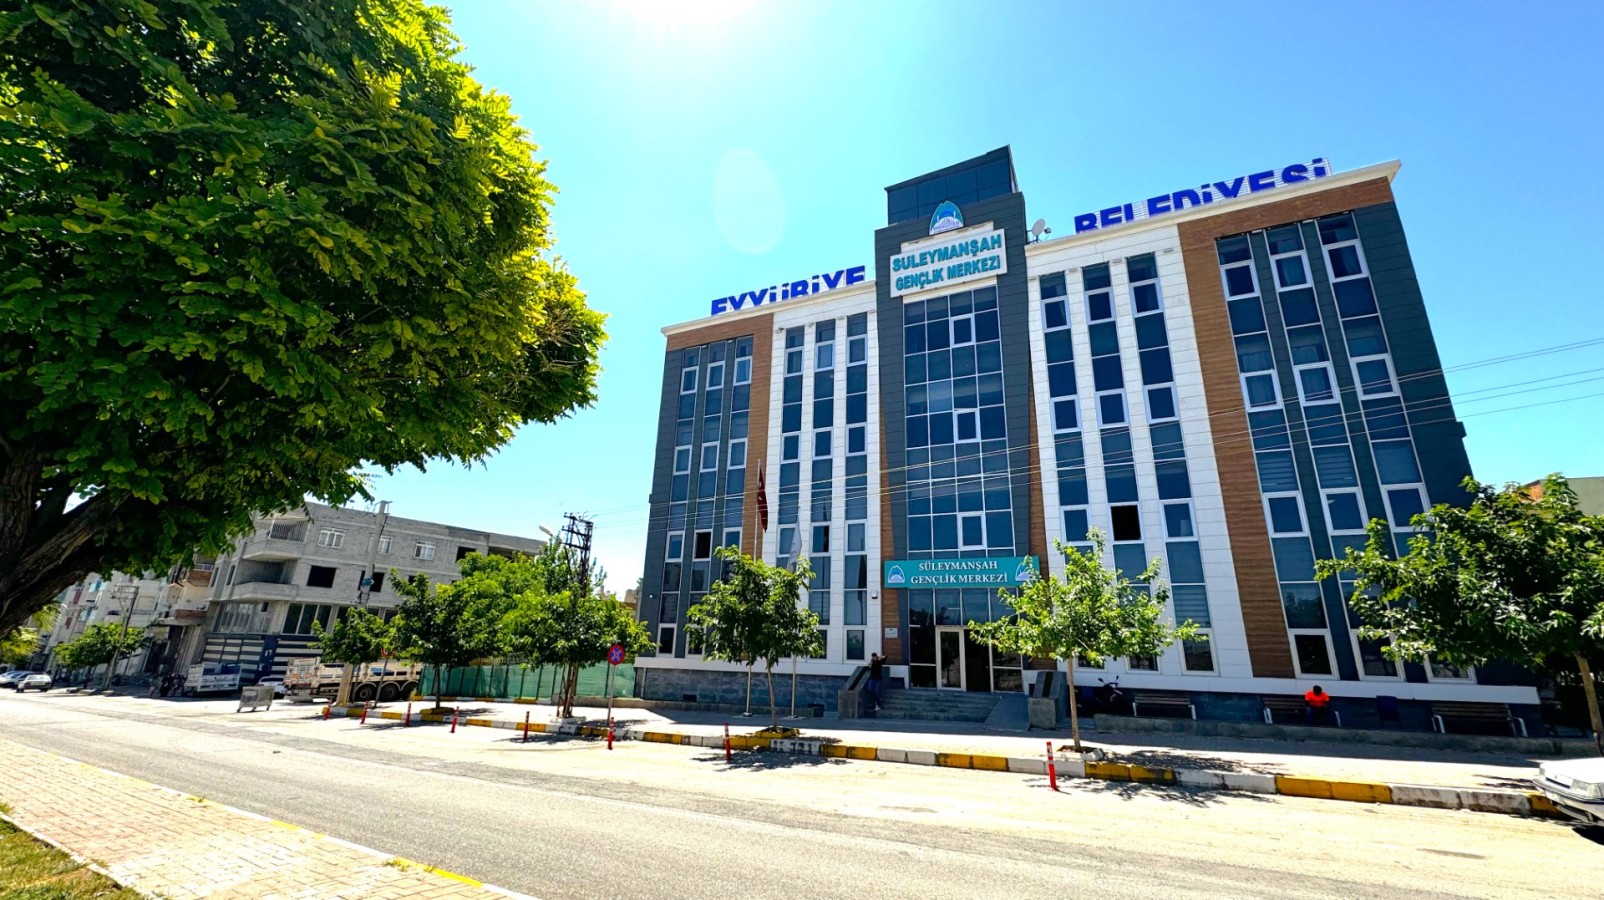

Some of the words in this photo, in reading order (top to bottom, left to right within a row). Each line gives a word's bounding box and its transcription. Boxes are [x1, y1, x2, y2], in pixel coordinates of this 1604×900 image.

[896, 267, 944, 291] GENÇLİK
[947, 255, 1001, 280] MERKEZİ
[918, 561, 998, 571] SÜLEYMANŞAH
[911, 574, 956, 585] GENÇLİK
[958, 573, 1008, 584] MERKEZİ
